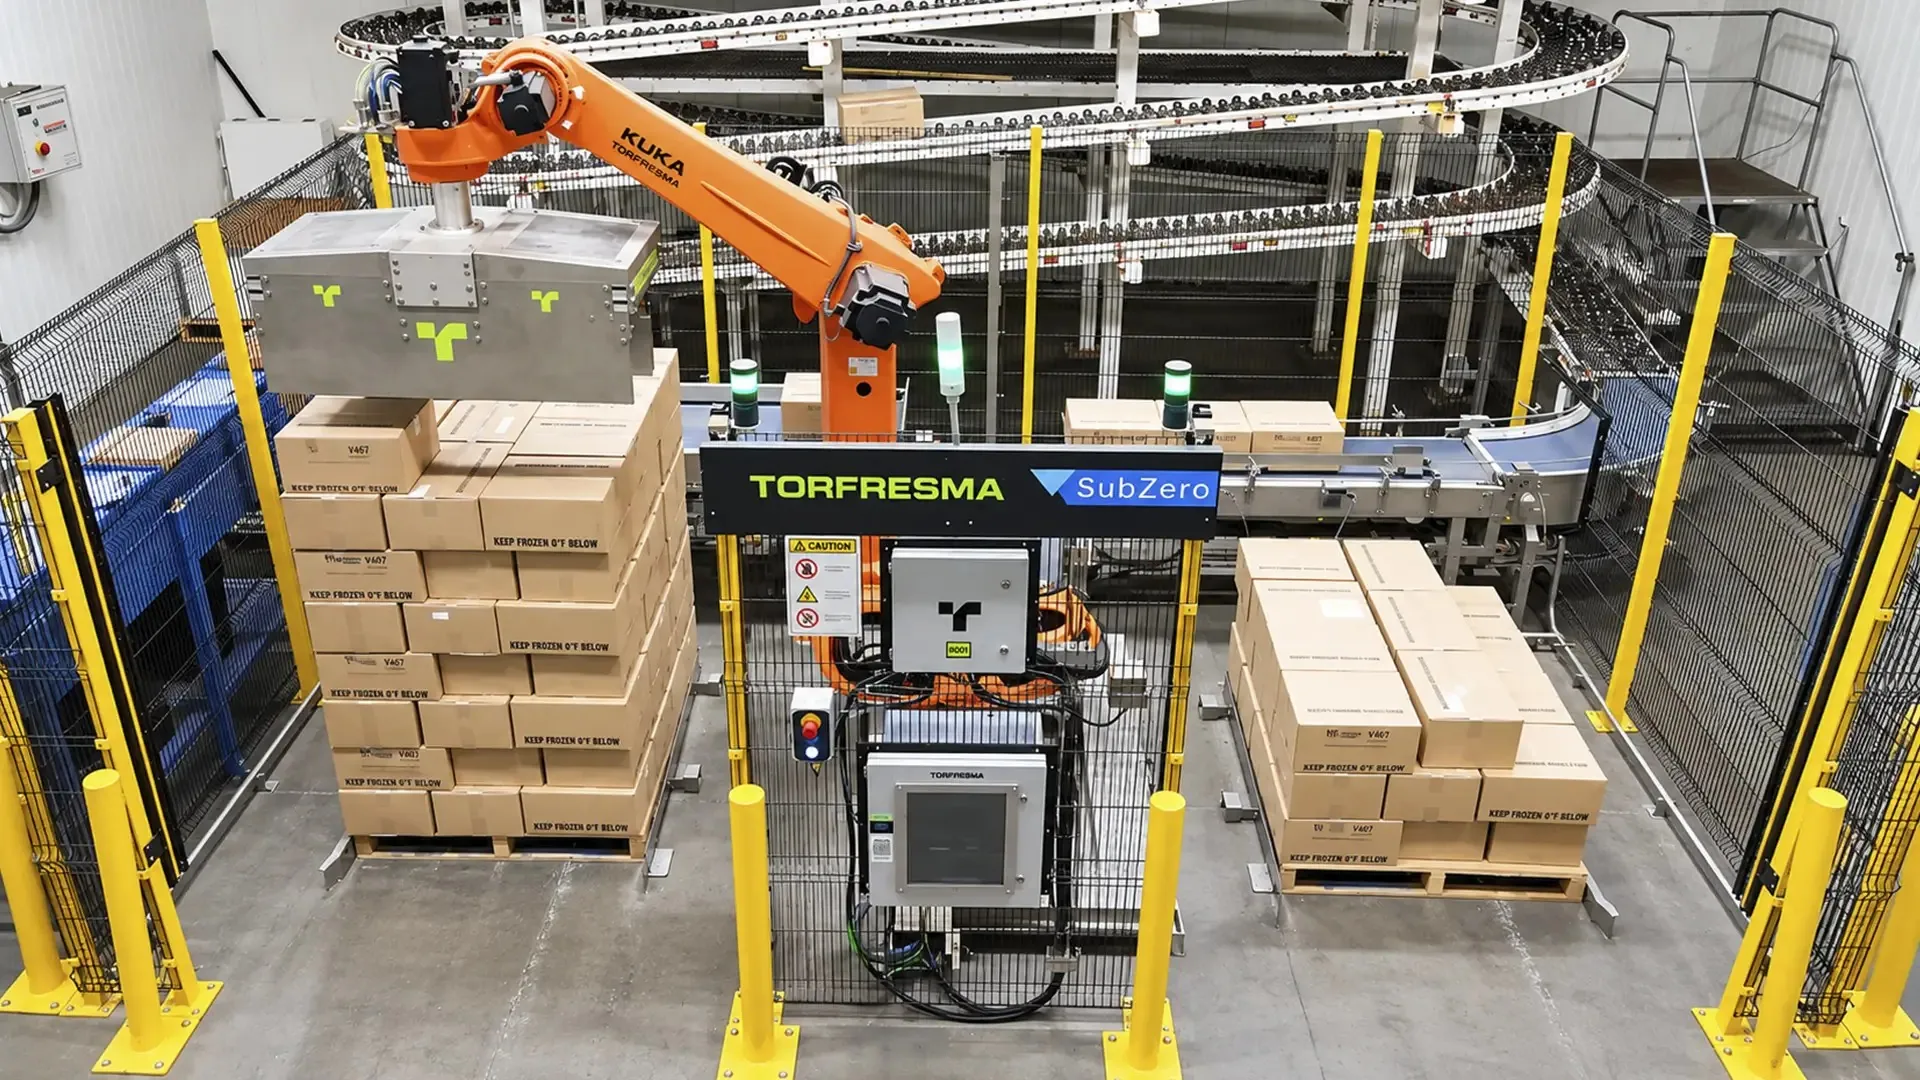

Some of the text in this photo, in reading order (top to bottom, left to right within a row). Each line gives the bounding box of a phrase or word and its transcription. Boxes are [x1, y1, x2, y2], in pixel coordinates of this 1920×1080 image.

[620, 127, 684, 176] KUKA
[612, 140, 679, 188] TORFRESMA
[292, 484, 314, 492] KEEP
[749, 475, 1005, 501] TORFRESMA
[1077, 476, 1210, 500] SubZero
[494, 536, 515, 547] KEEP
[517, 537, 549, 548] FROZEN
[568, 539, 598, 549] BELOW
[807, 541, 852, 551] CAUTION
[309, 590, 332, 599] KEEP
[333, 590, 366, 600] FROZEN
[383, 591, 413, 600] BELOW
[509, 640, 531, 650] KEEP
[532, 641, 563, 651] FROZEN
[581, 642, 610, 652] BELOW
[330, 688, 352, 698] KEEP
[352, 689, 385, 699] FROZEN
[401, 689, 429, 699] BELOW
[524, 735, 545, 745] KEEP
[546, 736, 576, 746] FROZEN
[593, 737, 621, 747] BELOW
[1303, 763, 1325, 772] KEEP
[1326, 764, 1358, 773] FROZEN
[1376, 764, 1406, 773] BELOW
[930, 771, 984, 780] TORFRESMA
[345, 778, 366, 787] KEEP
[367, 778, 398, 787] FROZEN
[415, 779, 442, 788] BELOW
[1489, 808, 1511, 819] KEEP
[1511, 810, 1543, 820] FROZEN
[1560, 812, 1590, 822] BELOW
[533, 822, 554, 832] KEEP
[555, 823, 585, 832] FROZEN
[601, 824, 629, 833] BELOW
[1290, 853, 1311, 862] KEEP
[1312, 854, 1343, 863] FROZEN
[1360, 855, 1388, 864] BELOW
